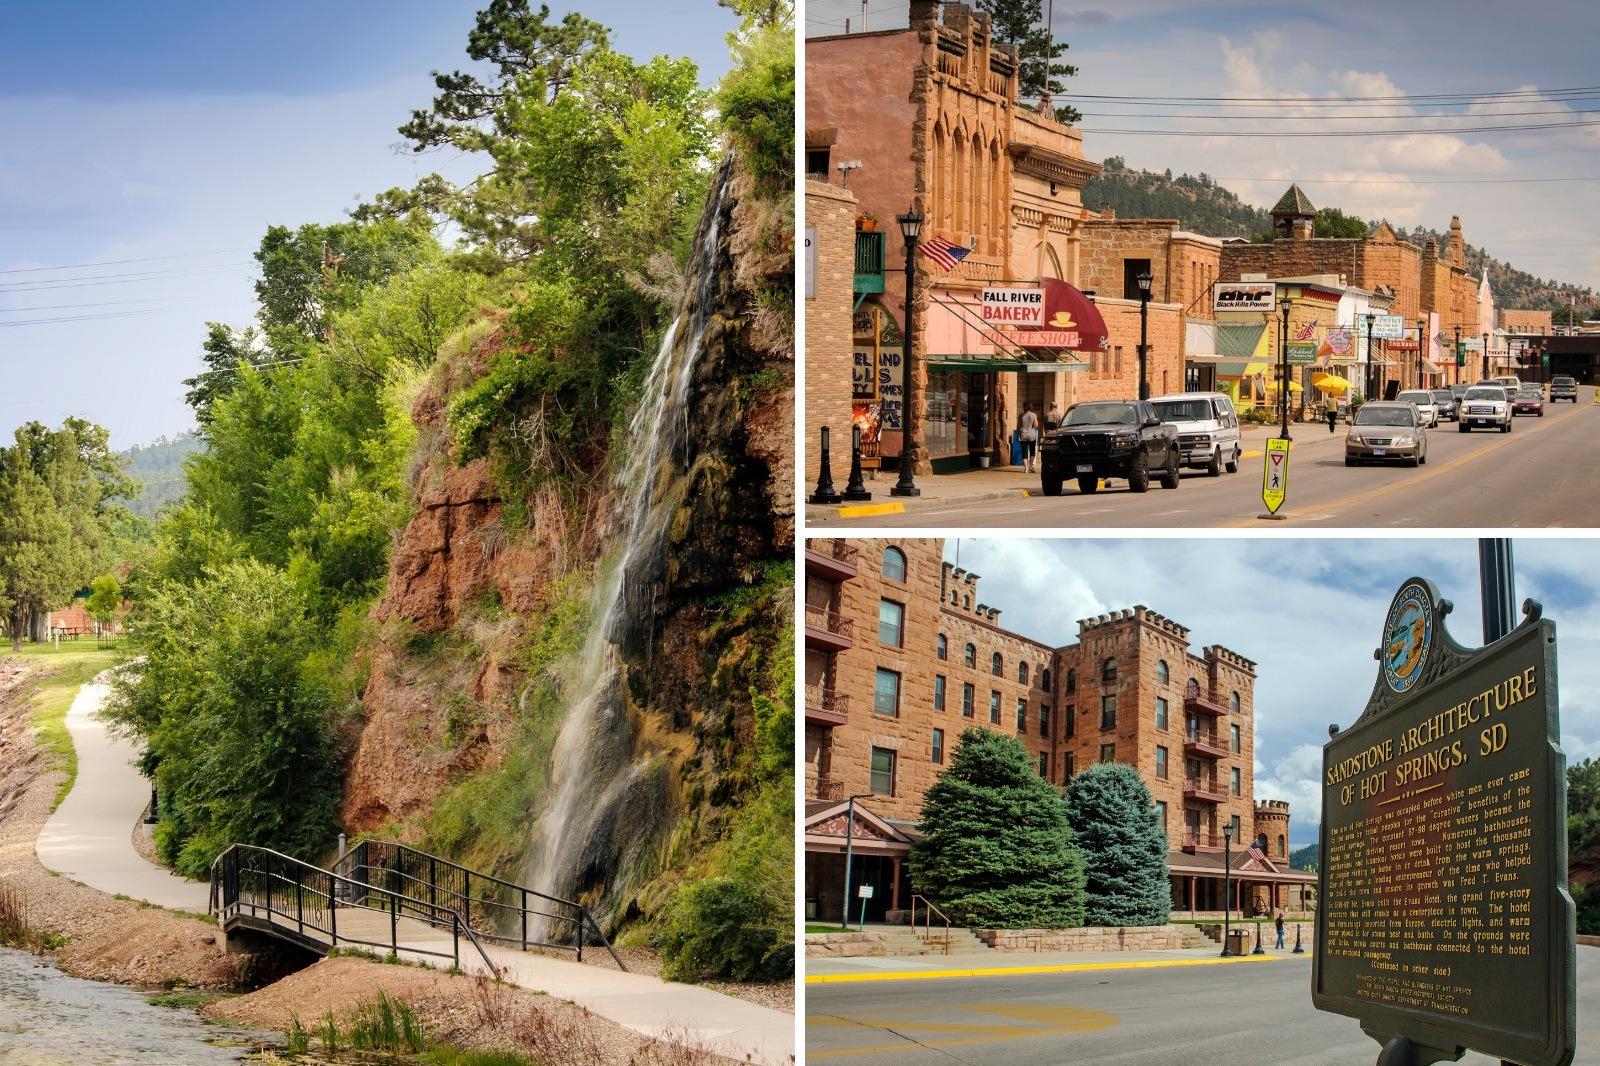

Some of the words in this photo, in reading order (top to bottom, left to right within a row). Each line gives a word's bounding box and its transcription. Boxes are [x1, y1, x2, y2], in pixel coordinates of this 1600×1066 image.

[983, 291, 1008, 302] FALL
[1010, 293, 1042, 303] RIVER
[983, 305, 1040, 321] BAKERY
[982, 331, 1036, 345] COFFEE
[1040, 331, 1077, 345] SHOP
[1327, 739, 1394, 786] SANDSTONE
[1398, 666, 1538, 756] ARCHITECTURE
[1341, 784, 1355, 806] OF
[1360, 770, 1388, 800] HOT
[1395, 740, 1468, 787] SPRINGS,
[1480, 722, 1508, 758] SD
[1423, 795, 1442, 808] before
[1446, 788, 1464, 801] white
[1468, 784, 1482, 795] men
[1487, 776, 1503, 789] ever
[1509, 767, 1529, 782] came
[1416, 813, 1425, 822] the
[1468, 793, 1498, 810] benefits
[1503, 789, 1511, 800] of
[1518, 784, 1530, 796] the
[1428, 818, 1451, 833] degree
[1456, 812, 1478, 825] waters
[1484, 803, 1512, 818] became
[1518, 798, 1530, 810] the
[1442, 826, 1476, 840] Numerous
[1409, 849, 1422, 857] were
[1426, 845, 1441, 855] built
[1445, 843, 1452, 851] to
[1456, 839, 1470, 849] host
[1476, 835, 1487, 845] the
[1493, 827, 1531, 843] thousands
[1414, 858, 1429, 867] drink
[1435, 855, 1450, 865] from
[1455, 852, 1466, 861] the
[1472, 849, 1491, 859] warm
[1498, 841, 1530, 857] springs.
[1437, 867, 1444, 876] of
[1449, 865, 1459, 874] the
[1466, 862, 1480, 872] time
[1486, 859, 1500, 869] who
[1505, 855, 1530, 867] helped
[1417, 879, 1438, 891] growth
[1443, 879, 1454, 887] was
[1460, 875, 1475, 885] Fred
[1495, 870, 1519, 882] Evans.
[1447, 894, 1457, 902] the
[1462, 891, 1482, 903] grand
[1490, 887, 1530, 900] five-story
[1409, 907, 1443, 917] centerpiece
[1460, 906, 1478, 914] town.
[1489, 903, 1503, 913] The
[1510, 902, 1530, 912] hotel
[1431, 918, 1456, 926] electric
[1462, 917, 1483, 928] lights,
[1489, 917, 1503, 926] and
[1509, 917, 1529, 925] warm
[1443, 930, 1451, 939] On
[1457, 931, 1467, 939] the
[1473, 931, 1503, 942] grounds
[1510, 931, 1529, 940] were
[1436, 943, 1470, 952] connected
[1477, 944, 1484, 952] to
[1491, 944, 1503, 953] the
[1509, 944, 1529, 954] hotel
[1412, 965, 1428, 973] other
[1433, 966, 1450, 976] side)
